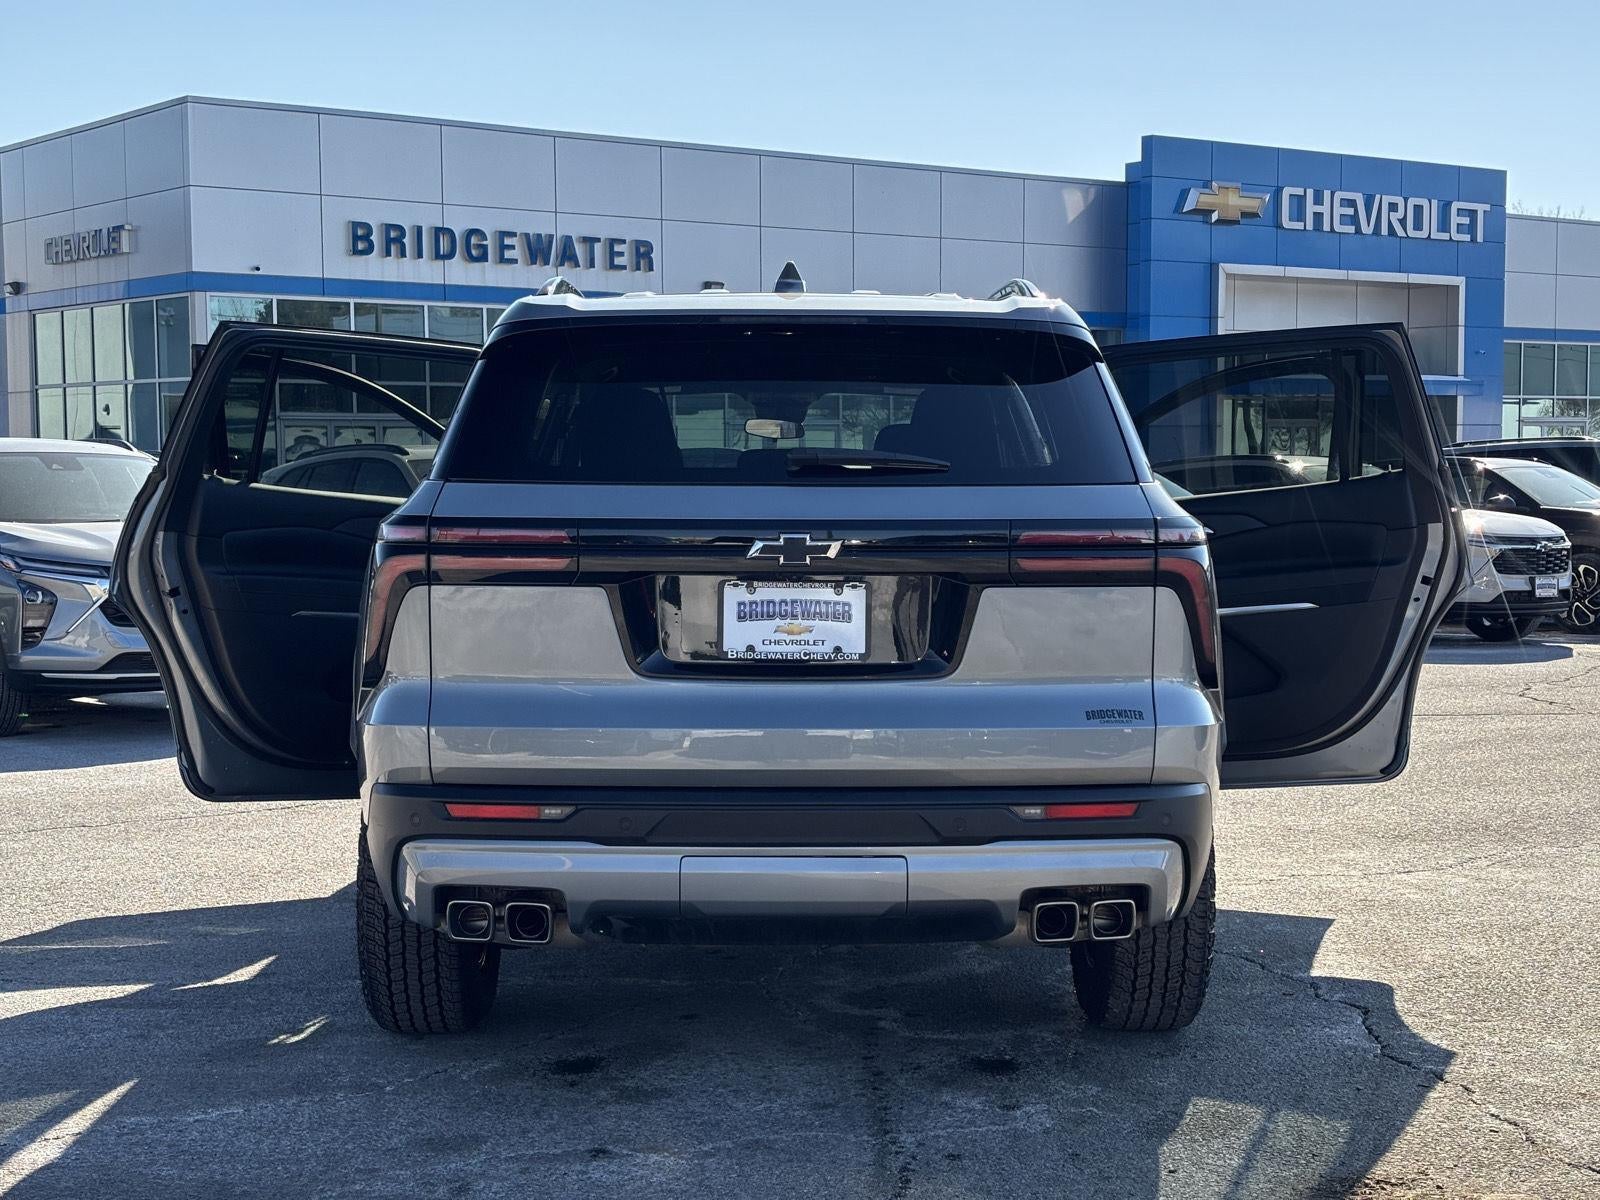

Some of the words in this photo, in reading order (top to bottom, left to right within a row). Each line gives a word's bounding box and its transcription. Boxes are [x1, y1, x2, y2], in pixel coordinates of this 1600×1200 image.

[1282, 186, 1491, 243] CHEVROLET
[44, 224, 133, 265] CHEVROLET
[347, 220, 655, 272] BRIDGEWATER
[736, 599, 853, 623] BRIDGEWATER
[1085, 709, 1145, 721] BRIDGEWATER
